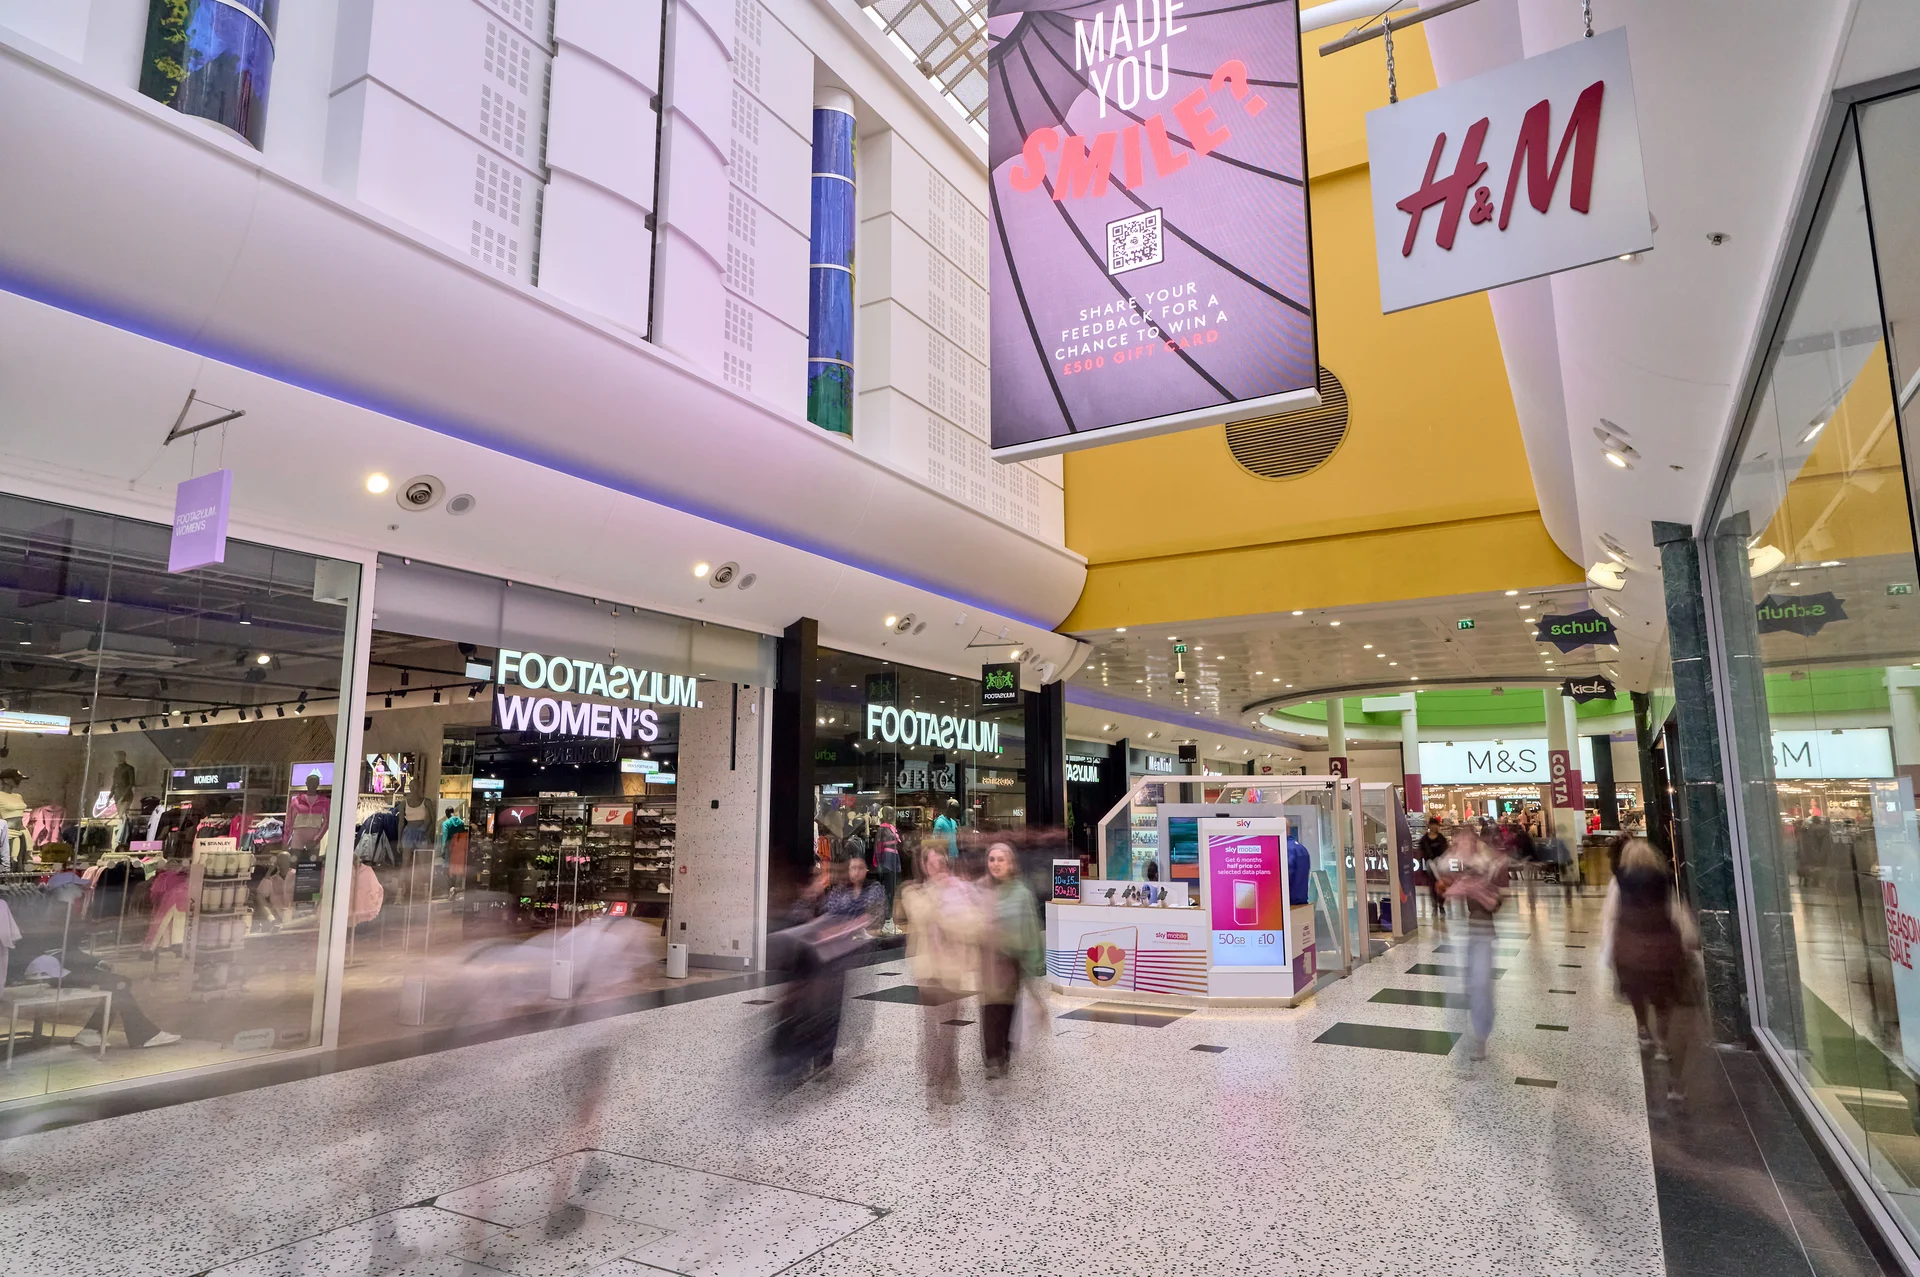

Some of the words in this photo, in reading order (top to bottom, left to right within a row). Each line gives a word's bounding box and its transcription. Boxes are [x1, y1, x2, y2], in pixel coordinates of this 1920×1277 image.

[1074, 0, 1187, 71] MADE
[1090, 43, 1169, 118] YOU
[1009, 59, 1267, 201] SMILE?
[1396, 80, 1604, 257] H&M
[1061, 309, 1153, 342] FEEDBACK
[1162, 300, 1198, 318] FOR
[1207, 294, 1219, 307] A
[1079, 296, 1137, 321] SHARE
[1145, 281, 1197, 305] YOUR
[1055, 332, 1128, 361] CHANCE
[1136, 326, 1159, 342] TO
[1169, 316, 1206, 334] WIN
[1215, 310, 1228, 323] A
[1063, 355, 1105, 376] £500
[1113, 344, 1155, 364] GIFT
[1164, 329, 1219, 353] CARD
[1550, 619, 1607, 635] schuh
[1570, 681, 1606, 694] kids
[497, 693, 659, 742] WOMEN'S
[1467, 749, 1537, 774] M&S
[1552, 754, 1568, 805] COSTA
[1237, 819, 1251, 828] sky
[1225, 846, 1237, 854] sky
[1881, 880, 1898, 909] MID
[1155, 931, 1166, 939] sky
[1167, 932, 1187, 940] mobile
[1218, 933, 1246, 945] 50GB
[1258, 933, 1275, 945] £10
[1886, 907, 1920, 945] SEASON
[1889, 935, 1913, 970] SALE
